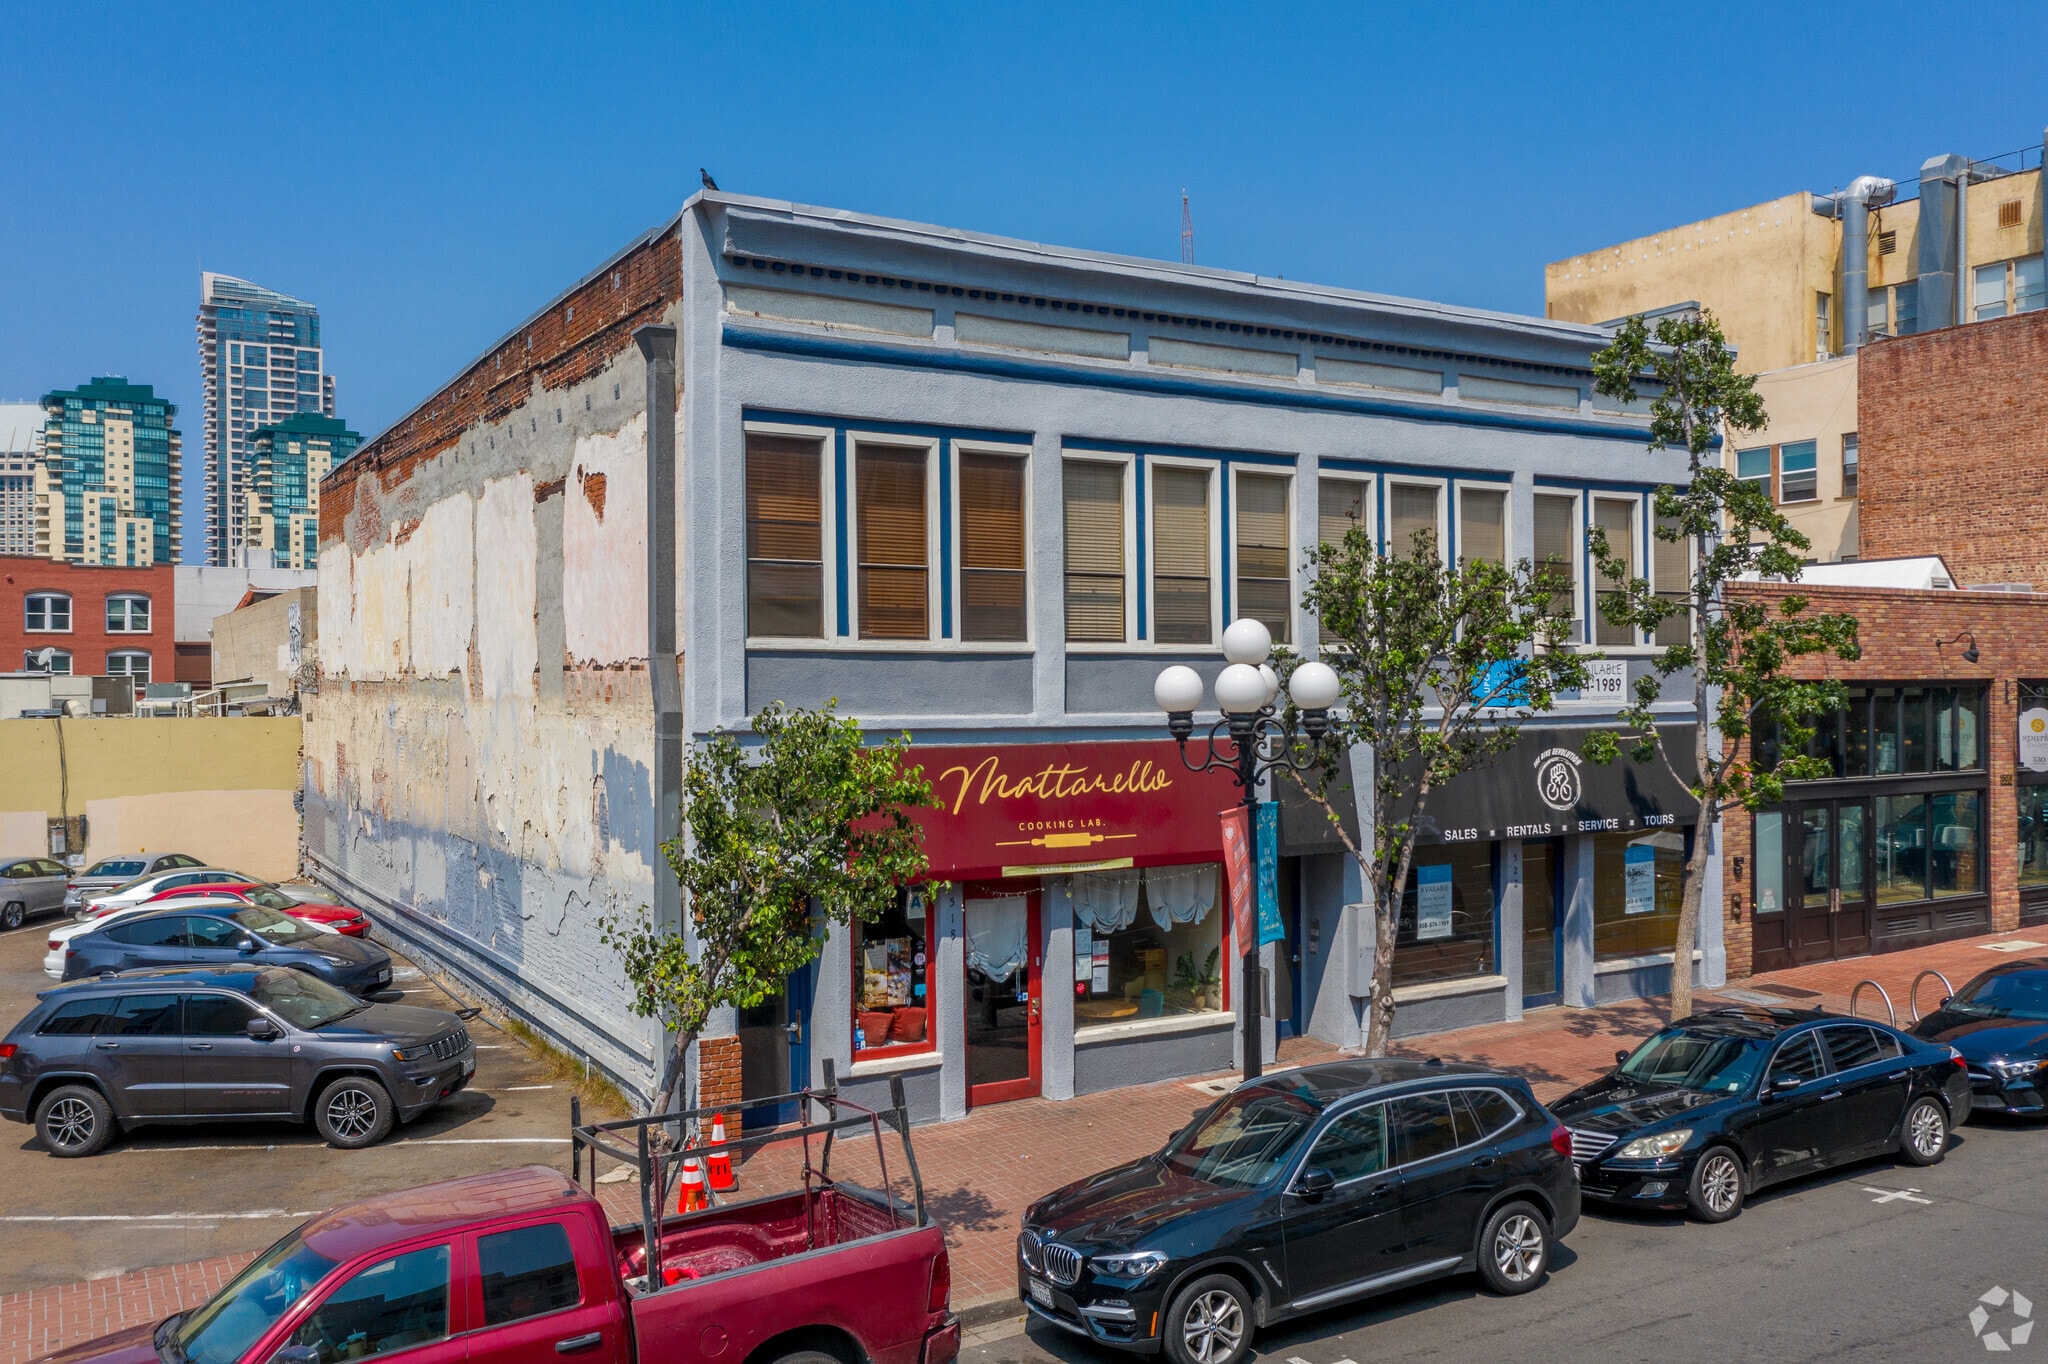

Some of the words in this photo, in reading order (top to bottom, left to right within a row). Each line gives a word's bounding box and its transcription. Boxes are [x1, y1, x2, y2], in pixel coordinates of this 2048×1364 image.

[1586, 663, 1622, 675] AILABLE
[939, 755, 1174, 816] Mattarello
[1019, 819, 1074, 831] COOKING
[1080, 818, 1106, 828] LAB.
[1444, 828, 1478, 841] SALES
[1506, 823, 1551, 837] RENTALS
[1578, 818, 1619, 831] SERVICE
[1644, 813, 1674, 826] TOURS
[1420, 884, 1449, 893] AVAILABLE
